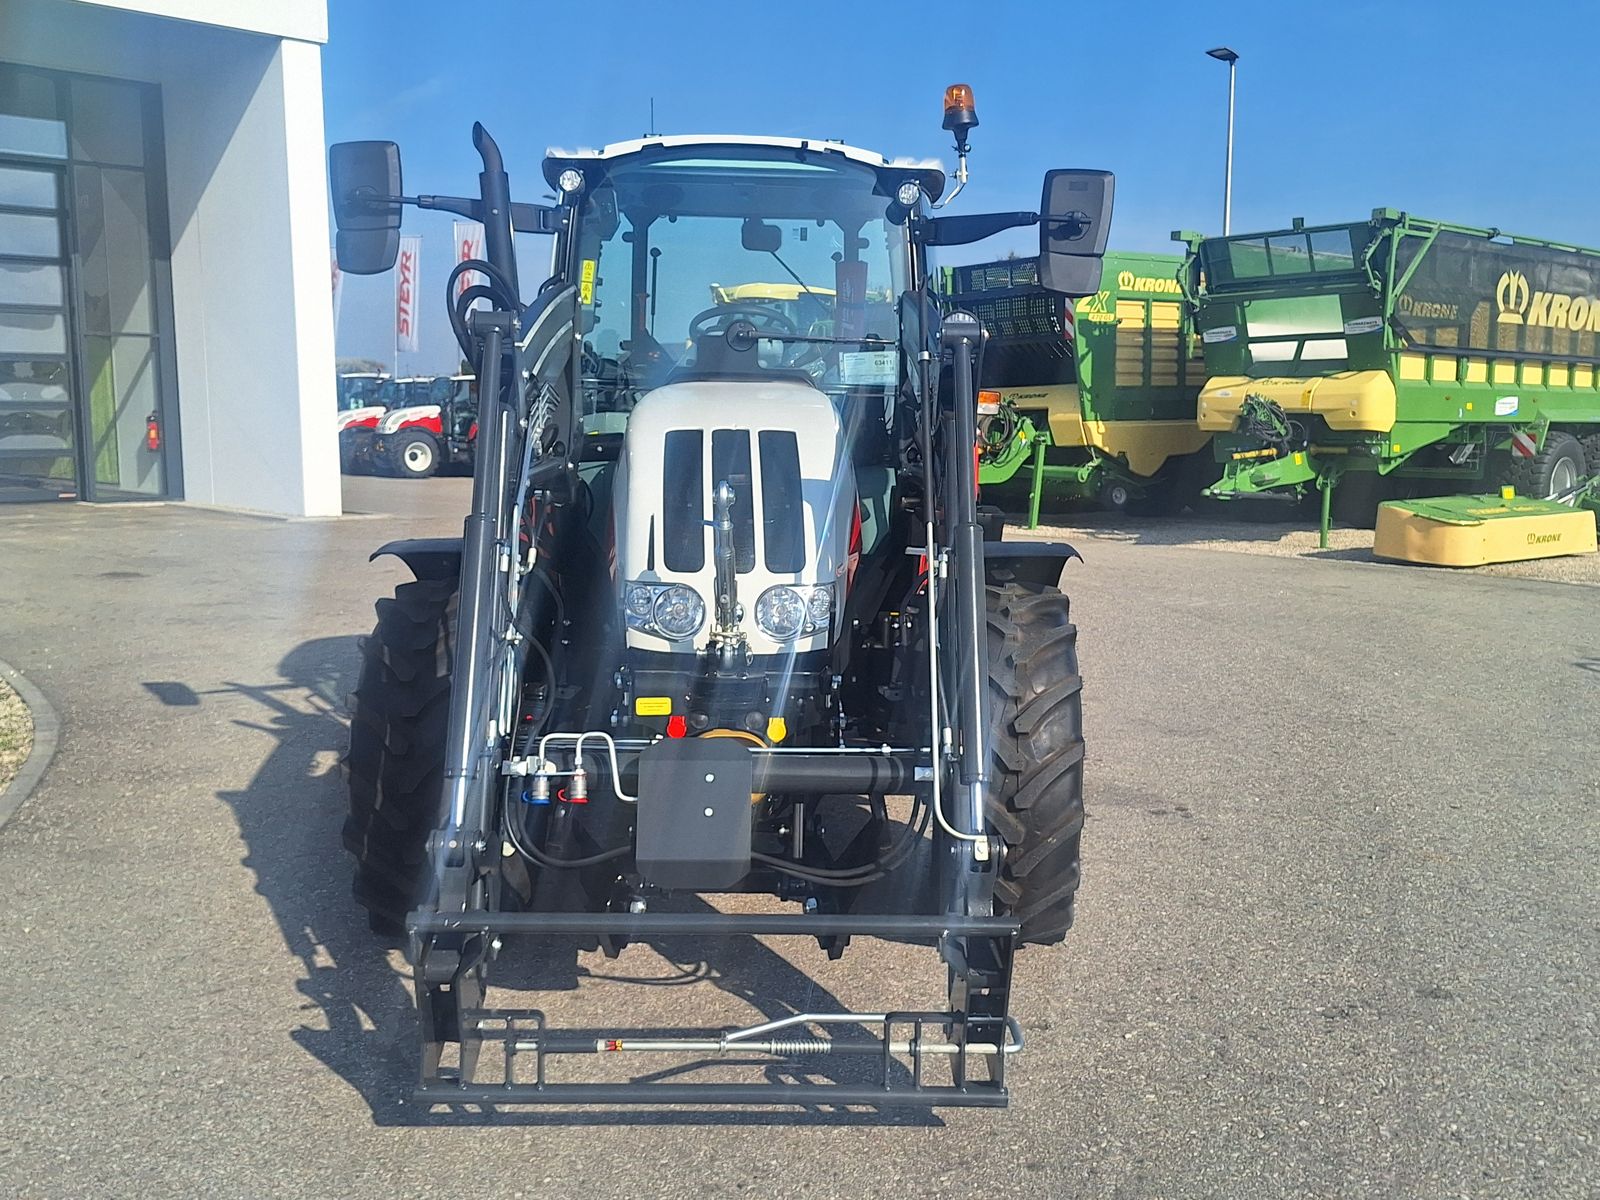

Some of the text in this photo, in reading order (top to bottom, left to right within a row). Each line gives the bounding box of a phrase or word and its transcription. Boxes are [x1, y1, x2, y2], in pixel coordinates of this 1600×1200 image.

[400, 251, 411, 337] STEYR
[1412, 301, 1459, 320] KRONE
[1527, 291, 1600, 332] KRON
[1535, 533, 1562, 543] KRONE
